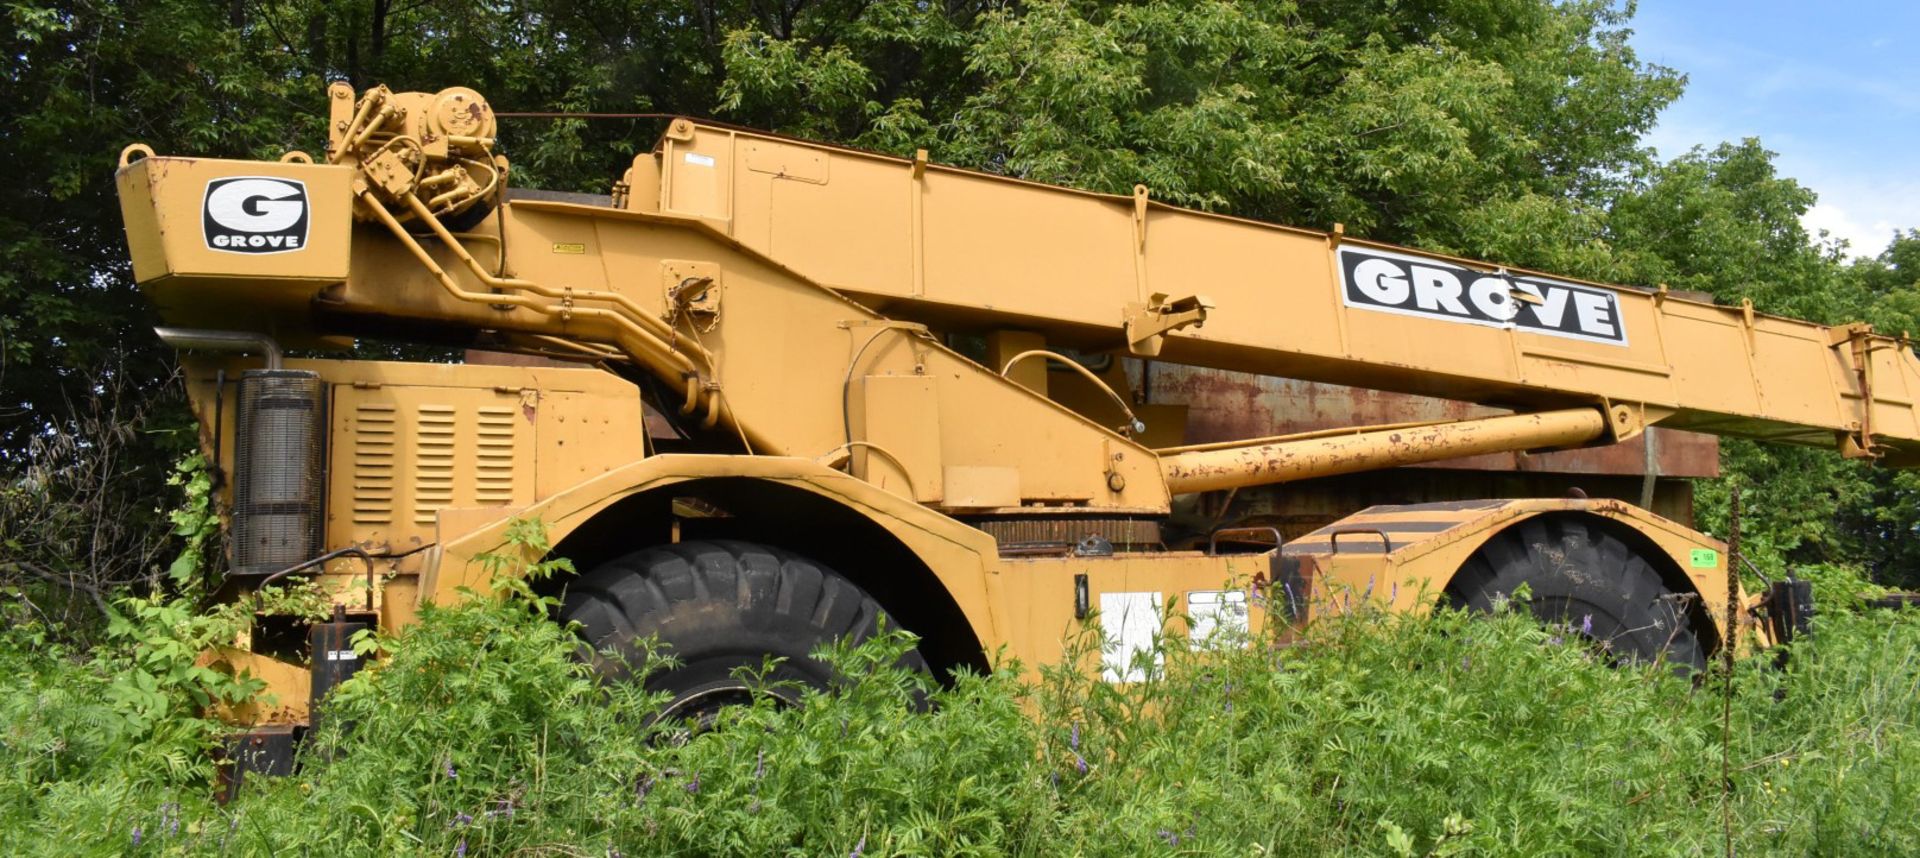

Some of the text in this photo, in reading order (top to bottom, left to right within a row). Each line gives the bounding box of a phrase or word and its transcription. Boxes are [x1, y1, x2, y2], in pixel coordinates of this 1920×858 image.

[208, 178, 303, 232] G
[213, 235, 298, 247] GROVE
[1353, 258, 1616, 337] GROVE
